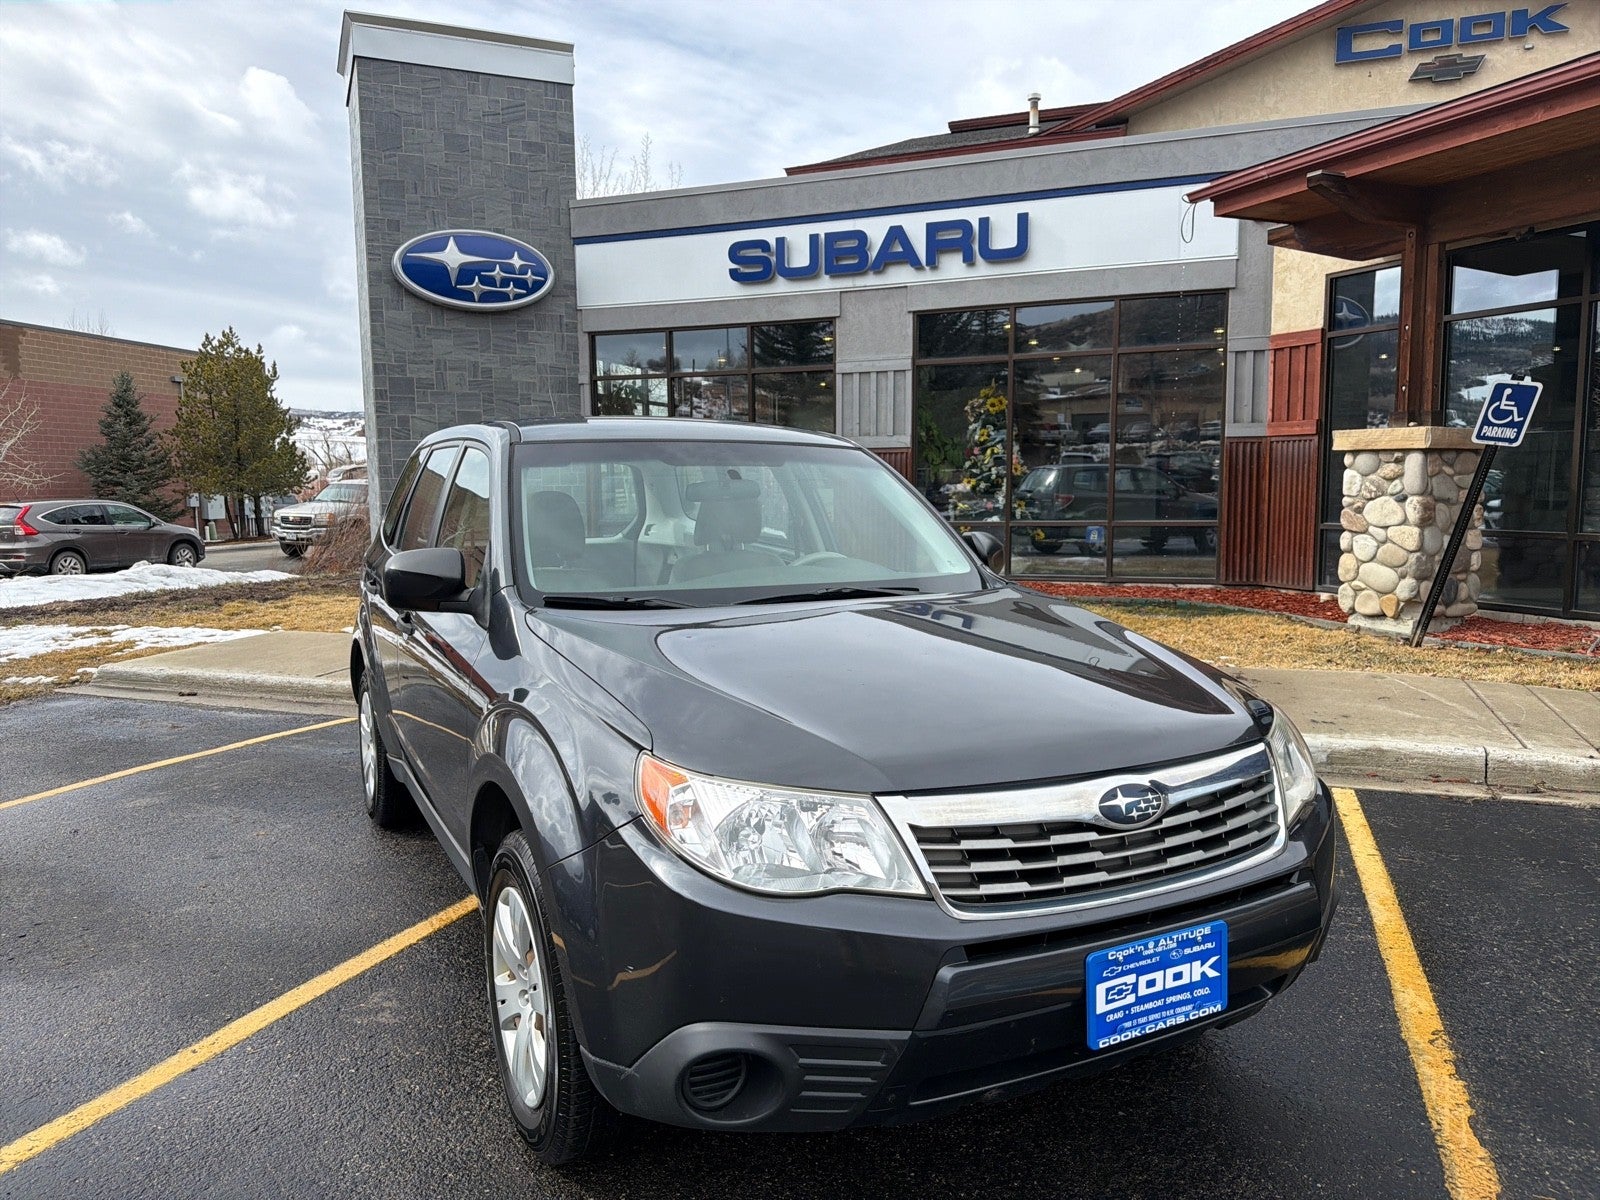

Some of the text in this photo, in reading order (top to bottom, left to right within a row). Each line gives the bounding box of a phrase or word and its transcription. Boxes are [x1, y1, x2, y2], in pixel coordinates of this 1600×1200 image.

[1334, 3, 1570, 64] COOK
[728, 212, 1029, 283] SUBARU
[1480, 425, 1518, 439] PARKING
[1158, 926, 1212, 947] ALTITUDE
[1183, 941, 1216, 955] SUBARU
[1122, 956, 1160, 971] CHEVROLET
[1096, 955, 1221, 1015] COOK
[1106, 1010, 1124, 1023] CRAIG
[1130, 998, 1165, 1014] STEAMBOAT
[1165, 991, 1192, 1004] SPRINGS,
[1193, 986, 1211, 997] COLO.
[1098, 1003, 1222, 1049] COOK-CARS.COM
